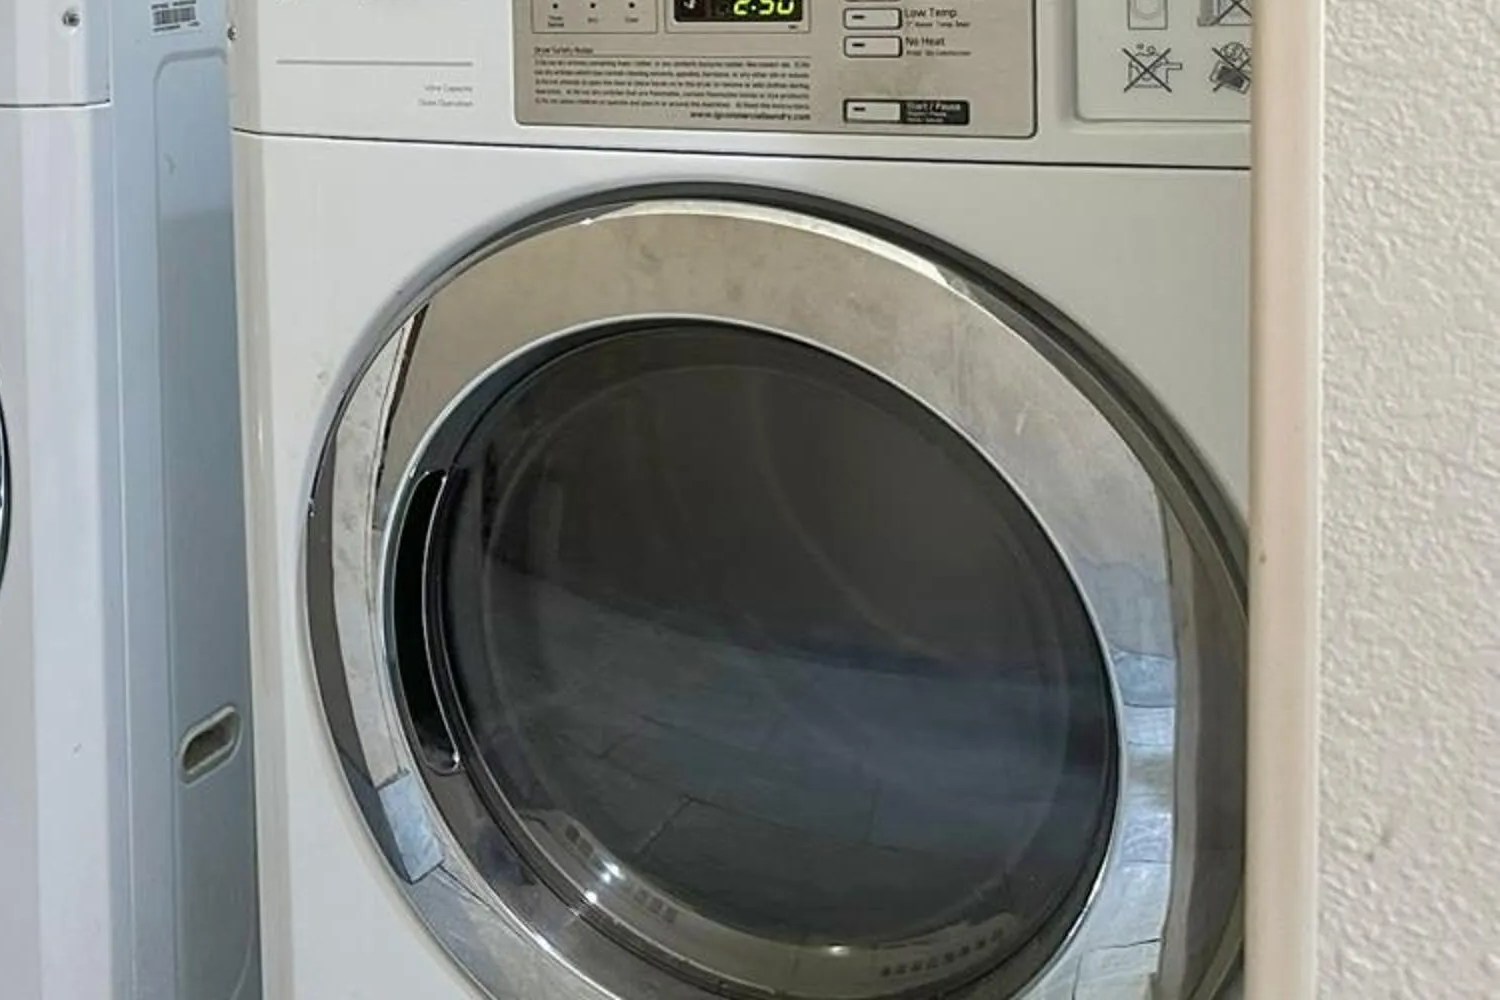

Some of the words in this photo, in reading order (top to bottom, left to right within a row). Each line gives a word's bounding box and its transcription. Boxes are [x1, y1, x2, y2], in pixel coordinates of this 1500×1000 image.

[904, 8, 927, 18] Low
[905, 37, 919, 47] No
[922, 37, 946, 47] Heat
